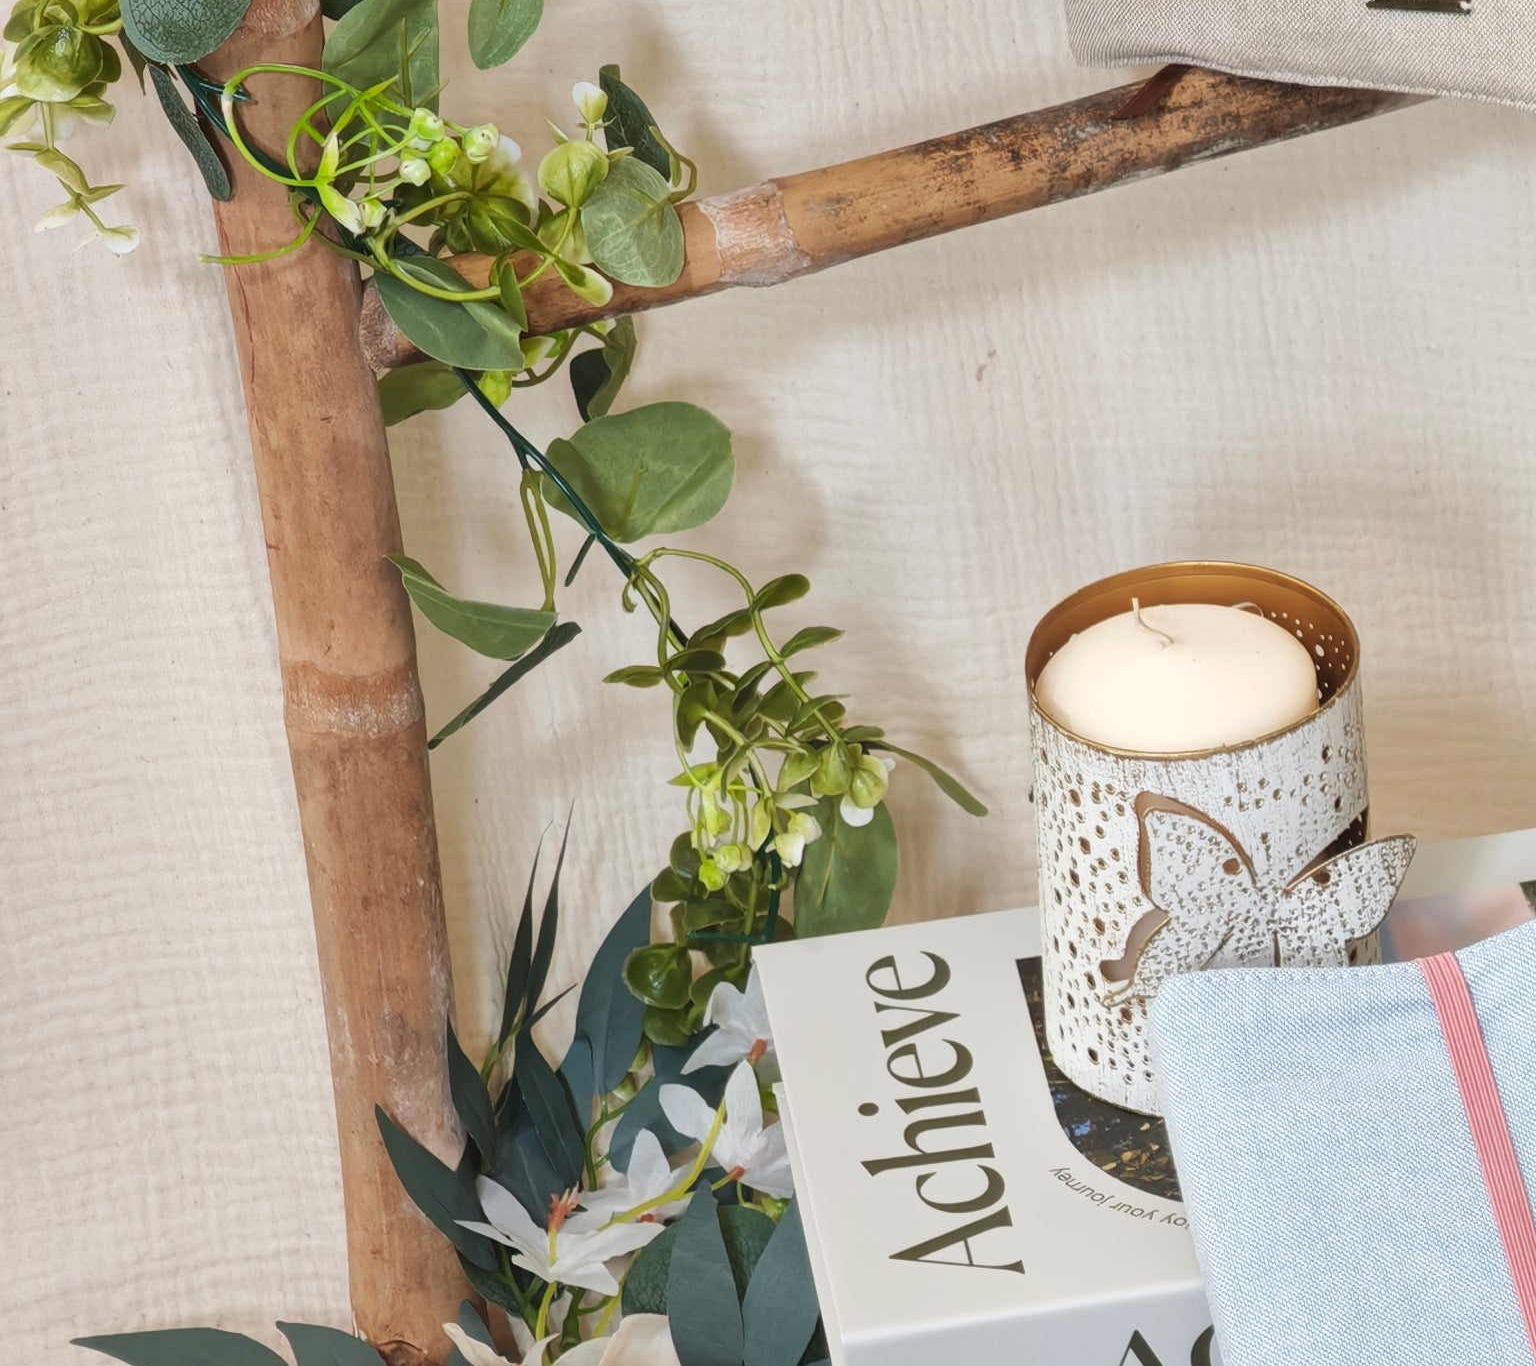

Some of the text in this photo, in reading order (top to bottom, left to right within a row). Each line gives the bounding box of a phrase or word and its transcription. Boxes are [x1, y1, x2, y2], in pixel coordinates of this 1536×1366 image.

[857, 949, 1025, 1276] Achieve
[1048, 1167, 1108, 1209] journey
[1109, 1201, 1161, 1221] your
